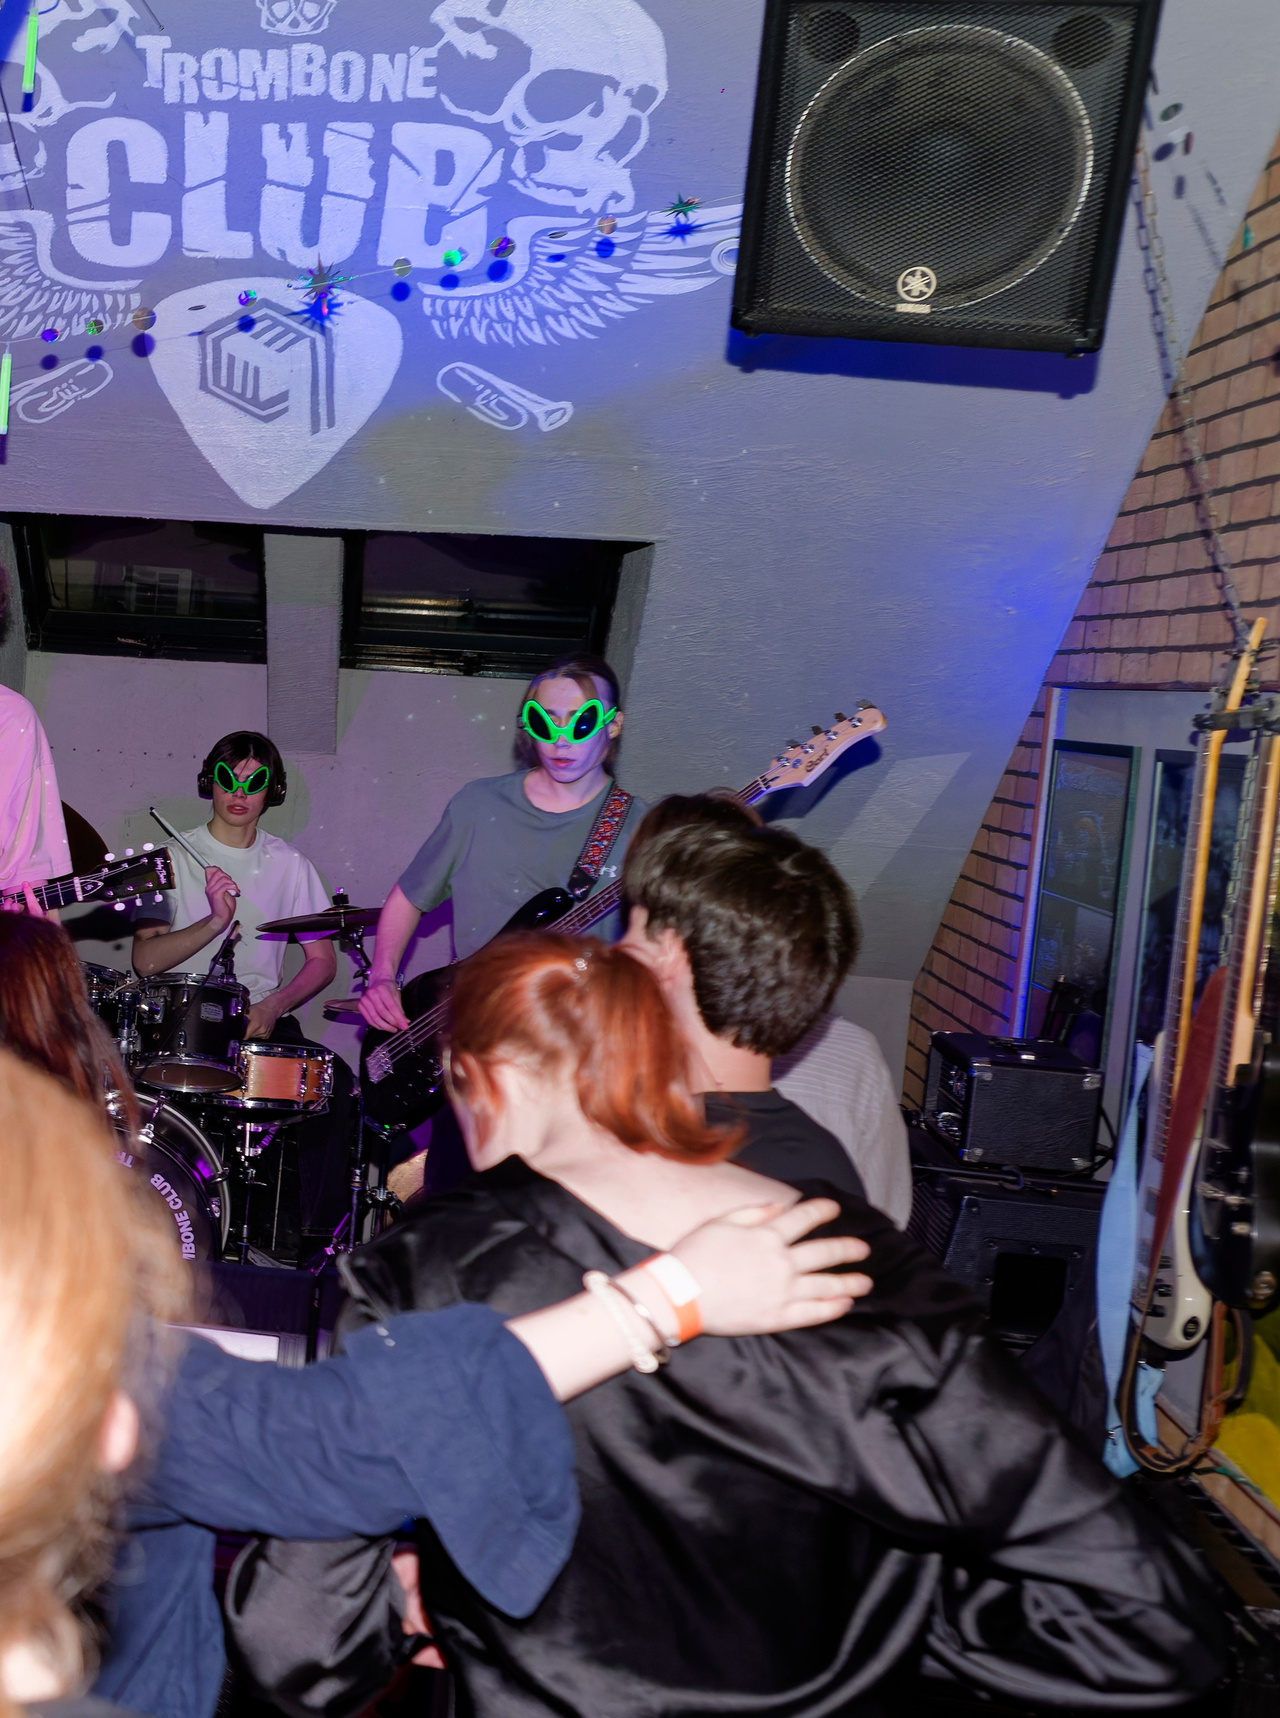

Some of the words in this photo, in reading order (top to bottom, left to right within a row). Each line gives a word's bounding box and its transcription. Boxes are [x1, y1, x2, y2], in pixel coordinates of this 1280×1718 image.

[135, 35, 439, 104] TROMBONE
[64, 110, 505, 271] CLUB
[149, 1173, 183, 1210] CLUB
